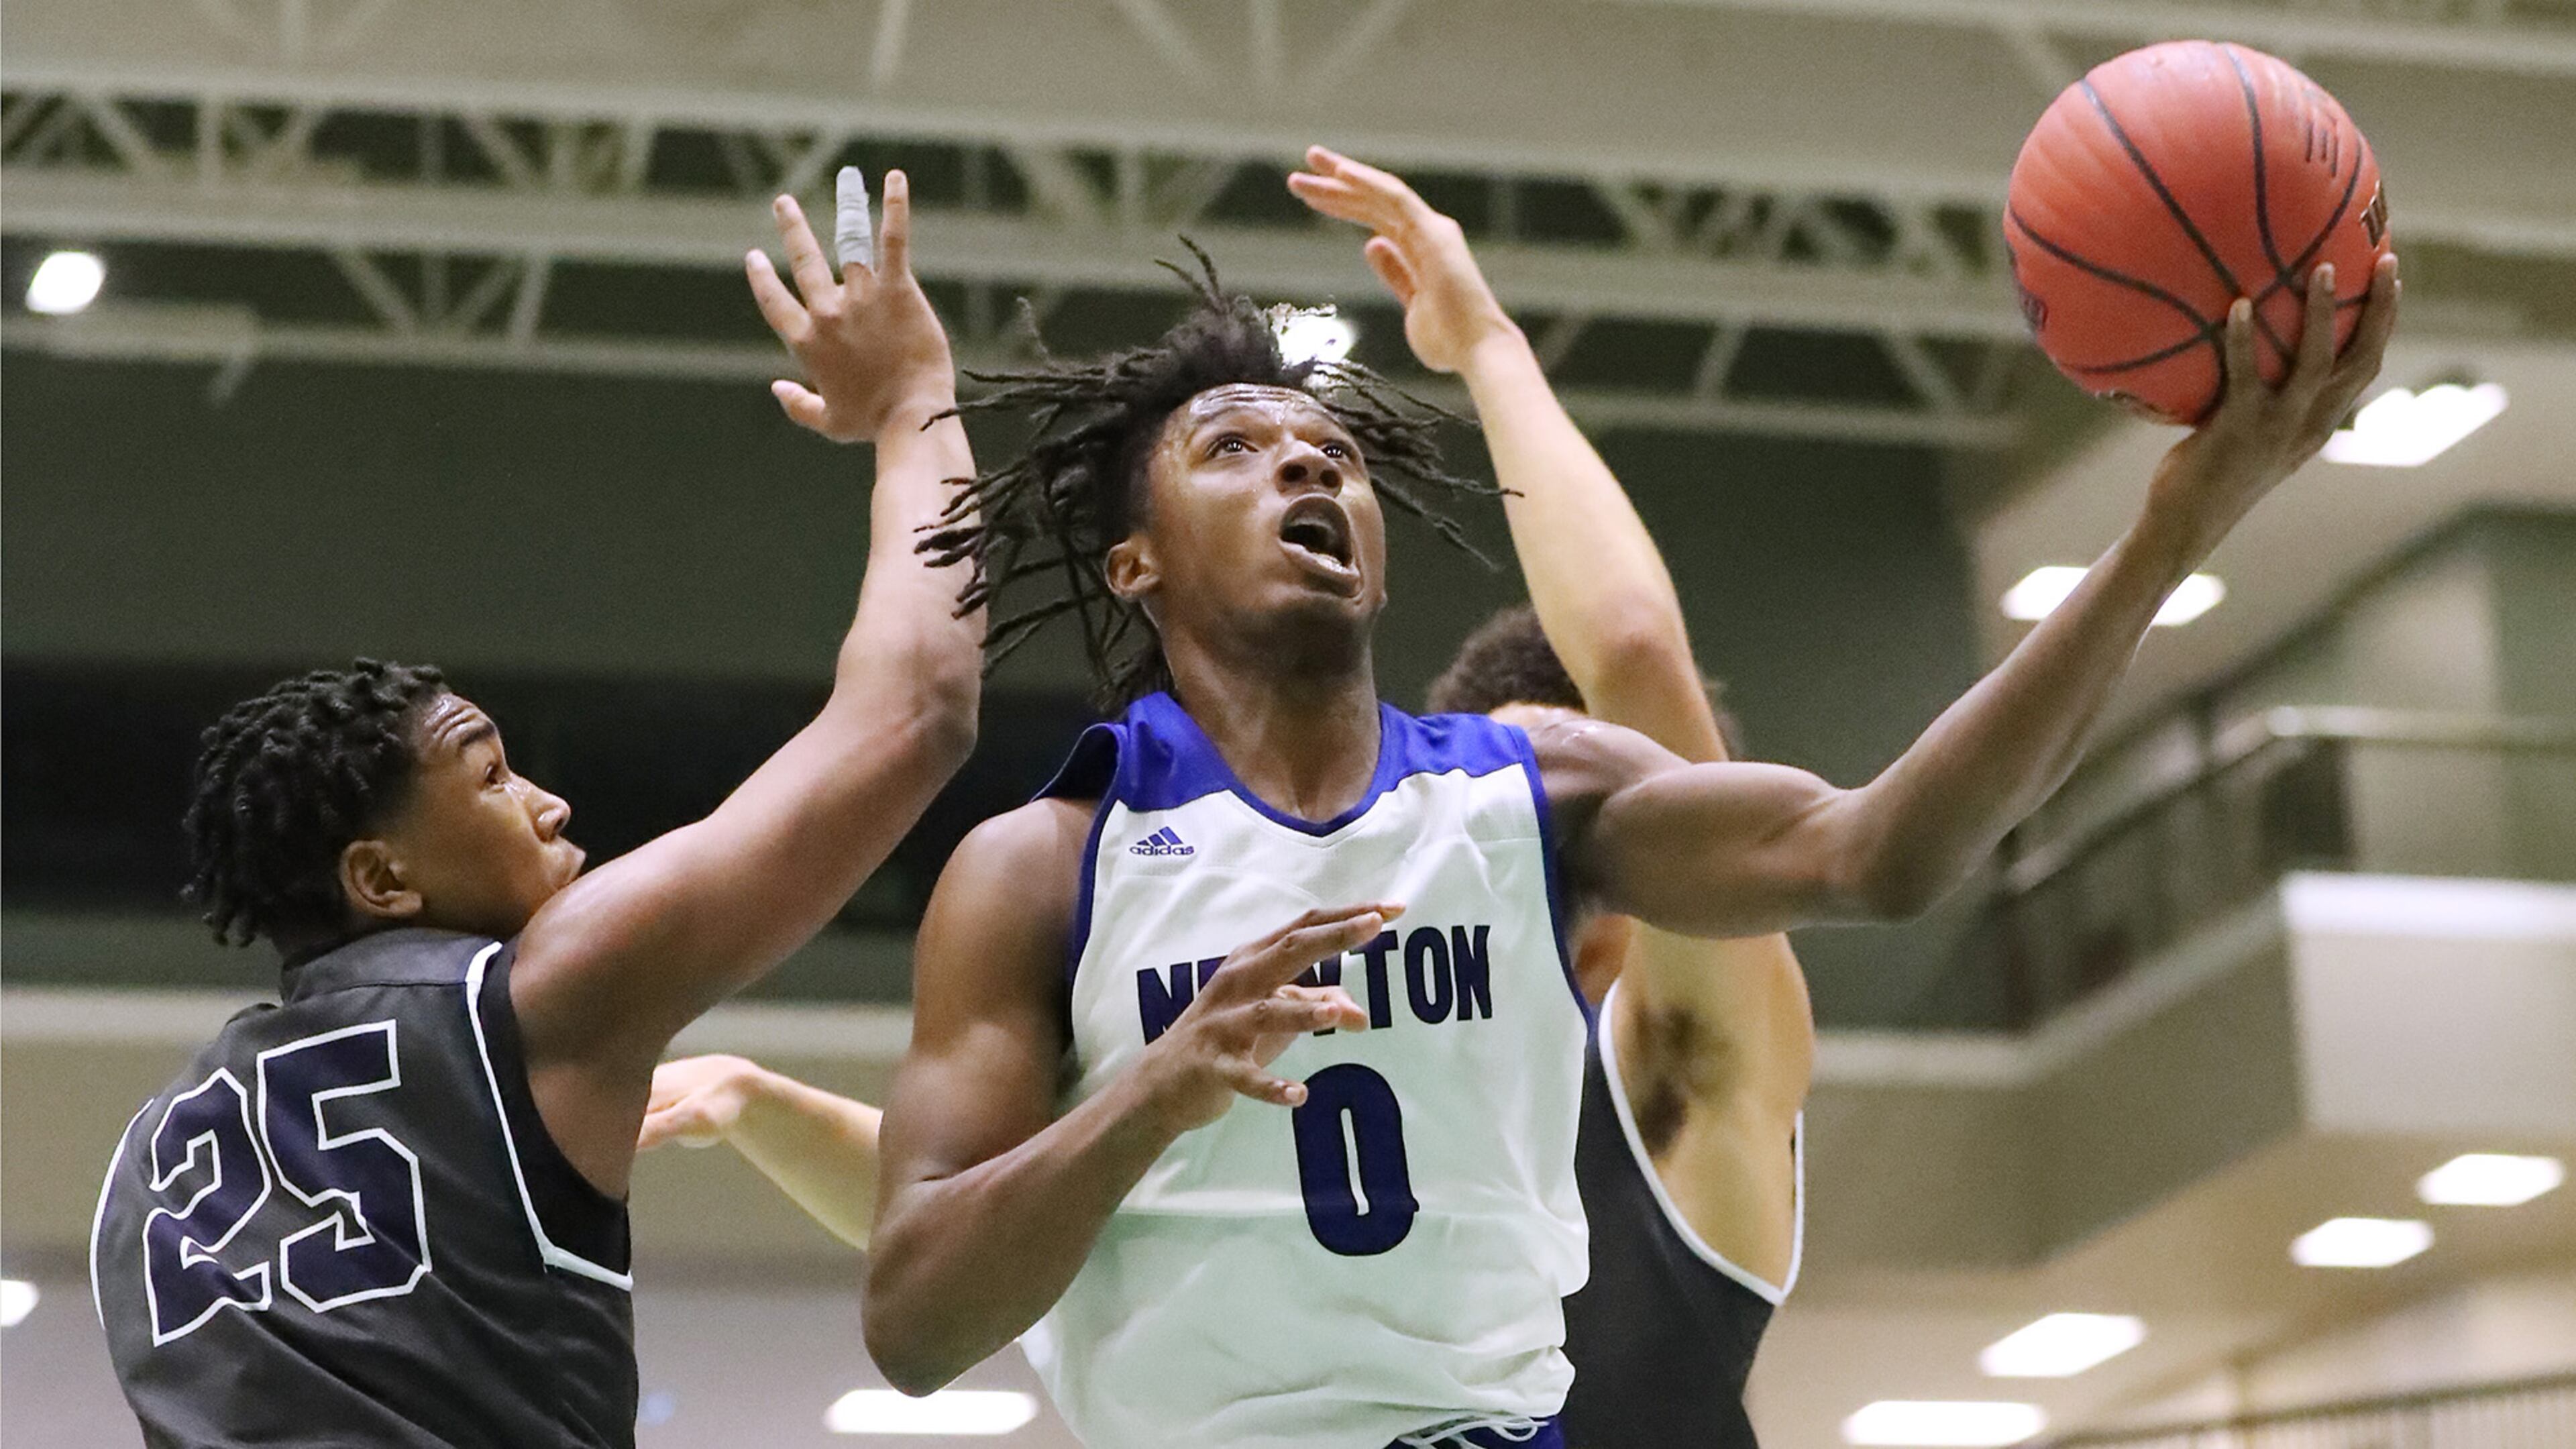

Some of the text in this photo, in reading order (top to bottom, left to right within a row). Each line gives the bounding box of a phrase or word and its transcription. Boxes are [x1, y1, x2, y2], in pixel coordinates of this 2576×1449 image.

[1129, 845, 1194, 856] adidas
[1136, 924, 1493, 1046] NTON
[142, 1019, 432, 1346] 25
[1292, 1063, 1420, 1256] 0
